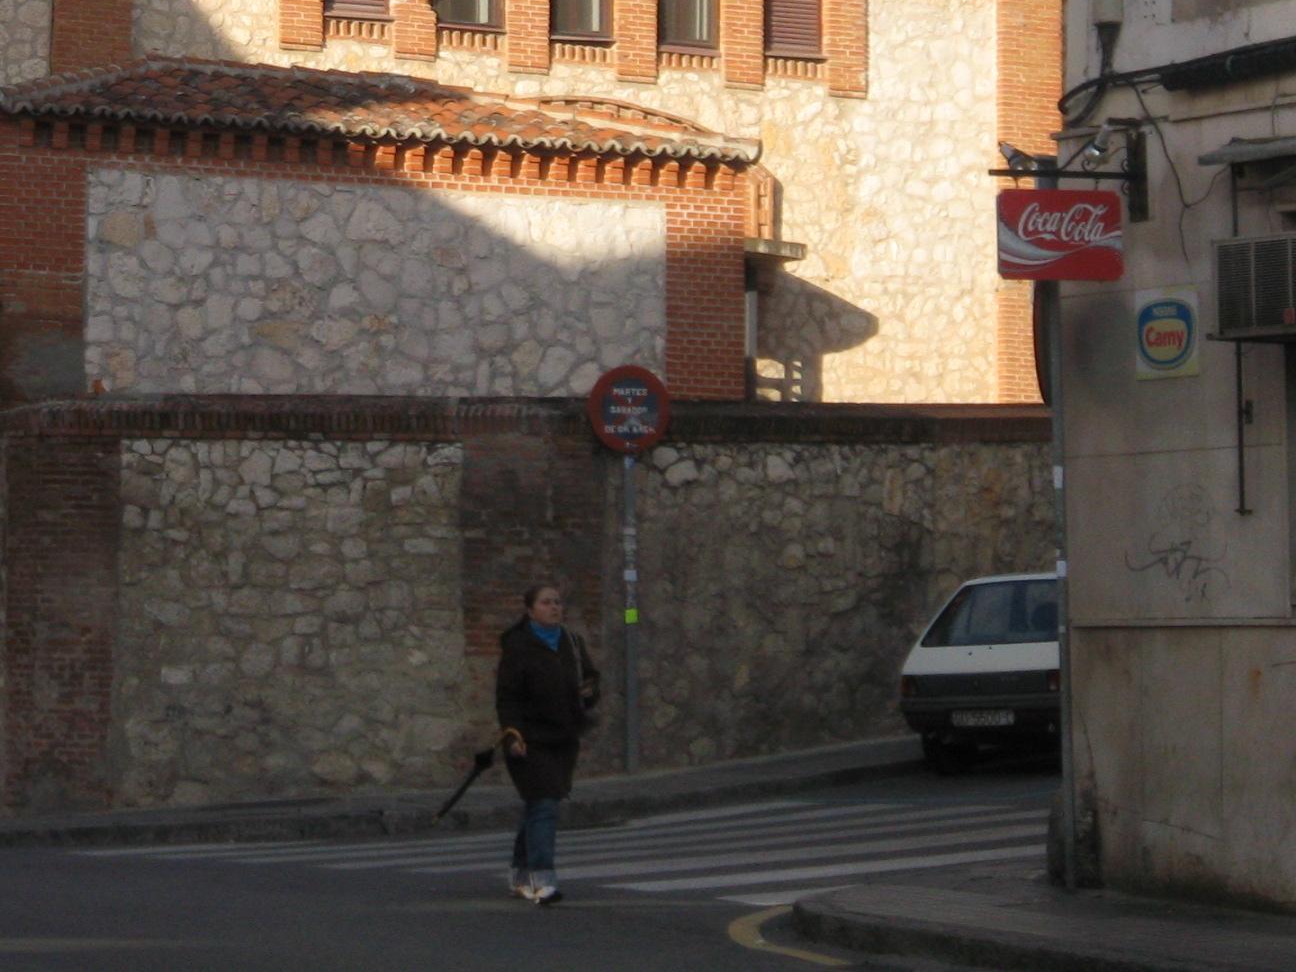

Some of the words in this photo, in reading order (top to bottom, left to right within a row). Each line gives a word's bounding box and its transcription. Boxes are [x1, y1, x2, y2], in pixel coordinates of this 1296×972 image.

[1017, 202, 1109, 242] Coca-Cola
[1145, 326, 1185, 350] Camy
[612, 388, 648, 396] MARTES
